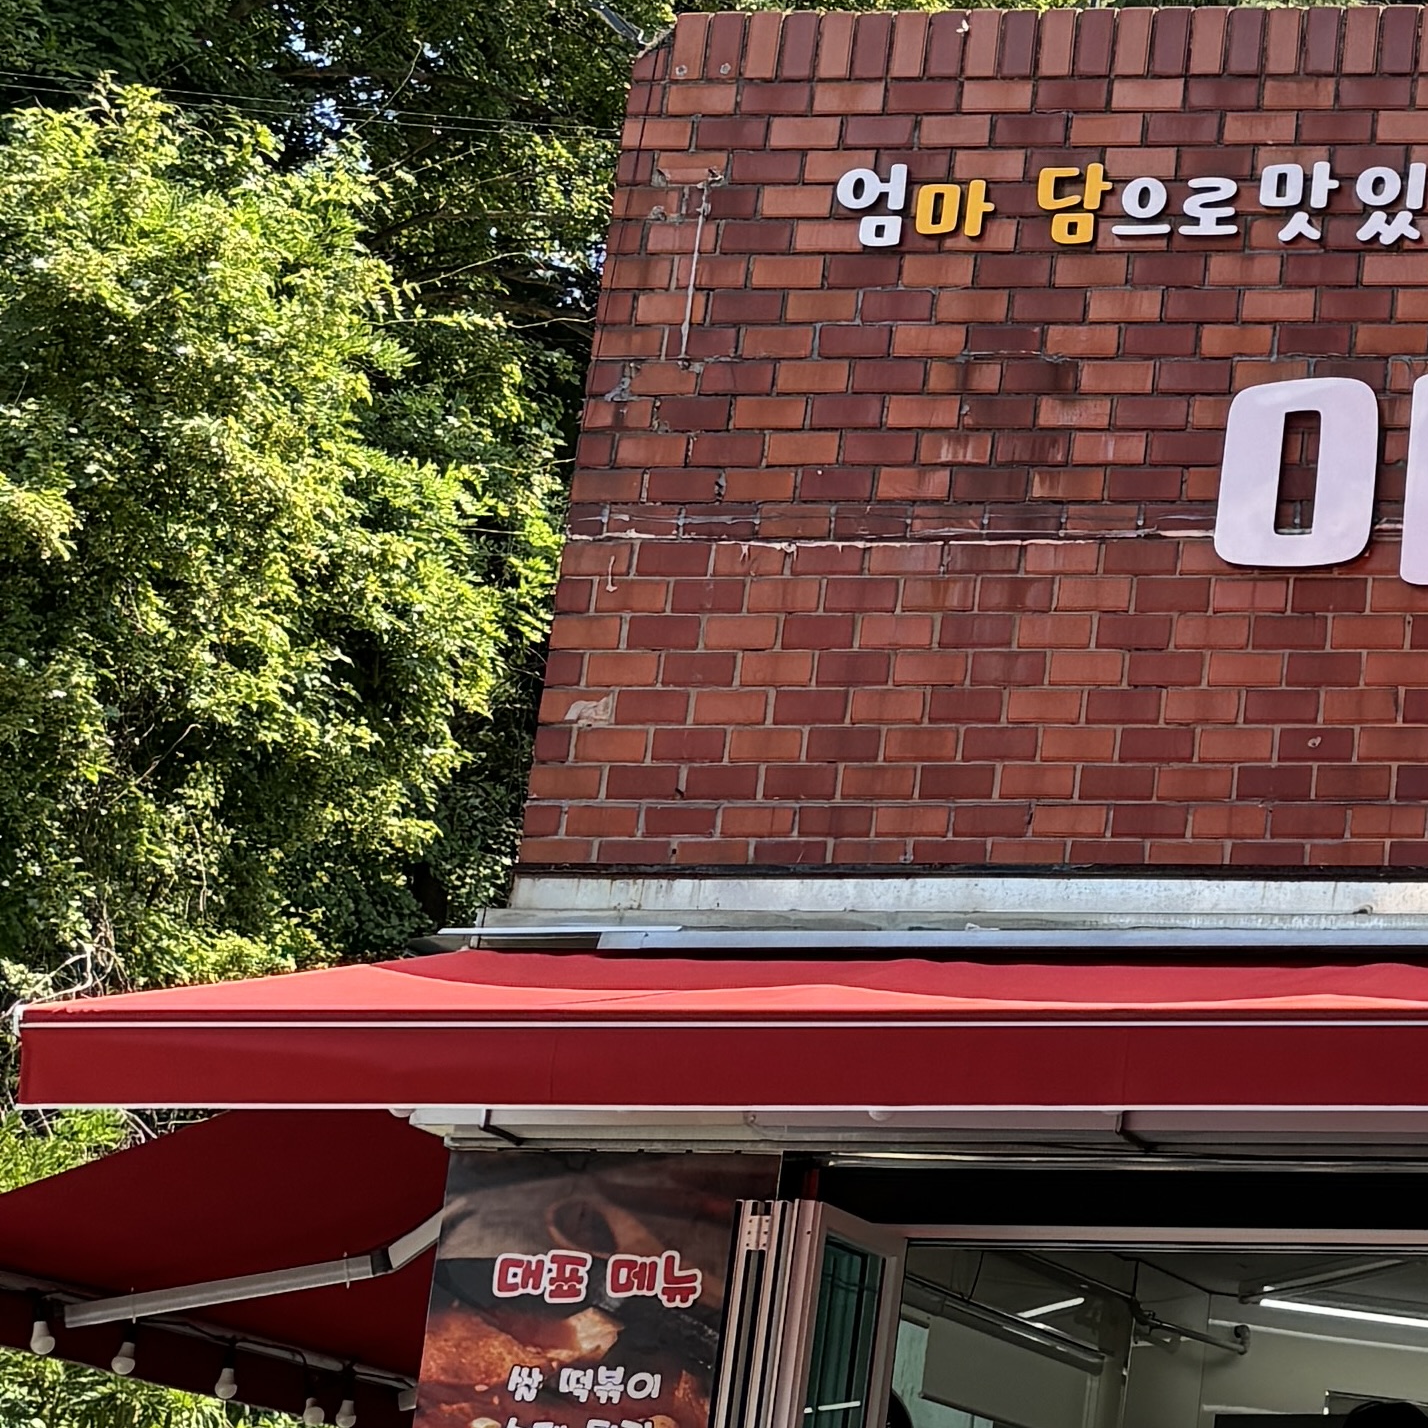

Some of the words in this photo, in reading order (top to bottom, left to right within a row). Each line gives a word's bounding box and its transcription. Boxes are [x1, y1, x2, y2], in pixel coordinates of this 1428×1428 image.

[836, 163, 995, 247] 엄마
[1037, 162, 1238, 245] 담으로
[493, 1250, 592, 1303] 대표
[607, 1251, 702, 1307] 메뉴
[507, 1366, 543, 1401] 쌀
[559, 1366, 661, 1404] 떡볶이
